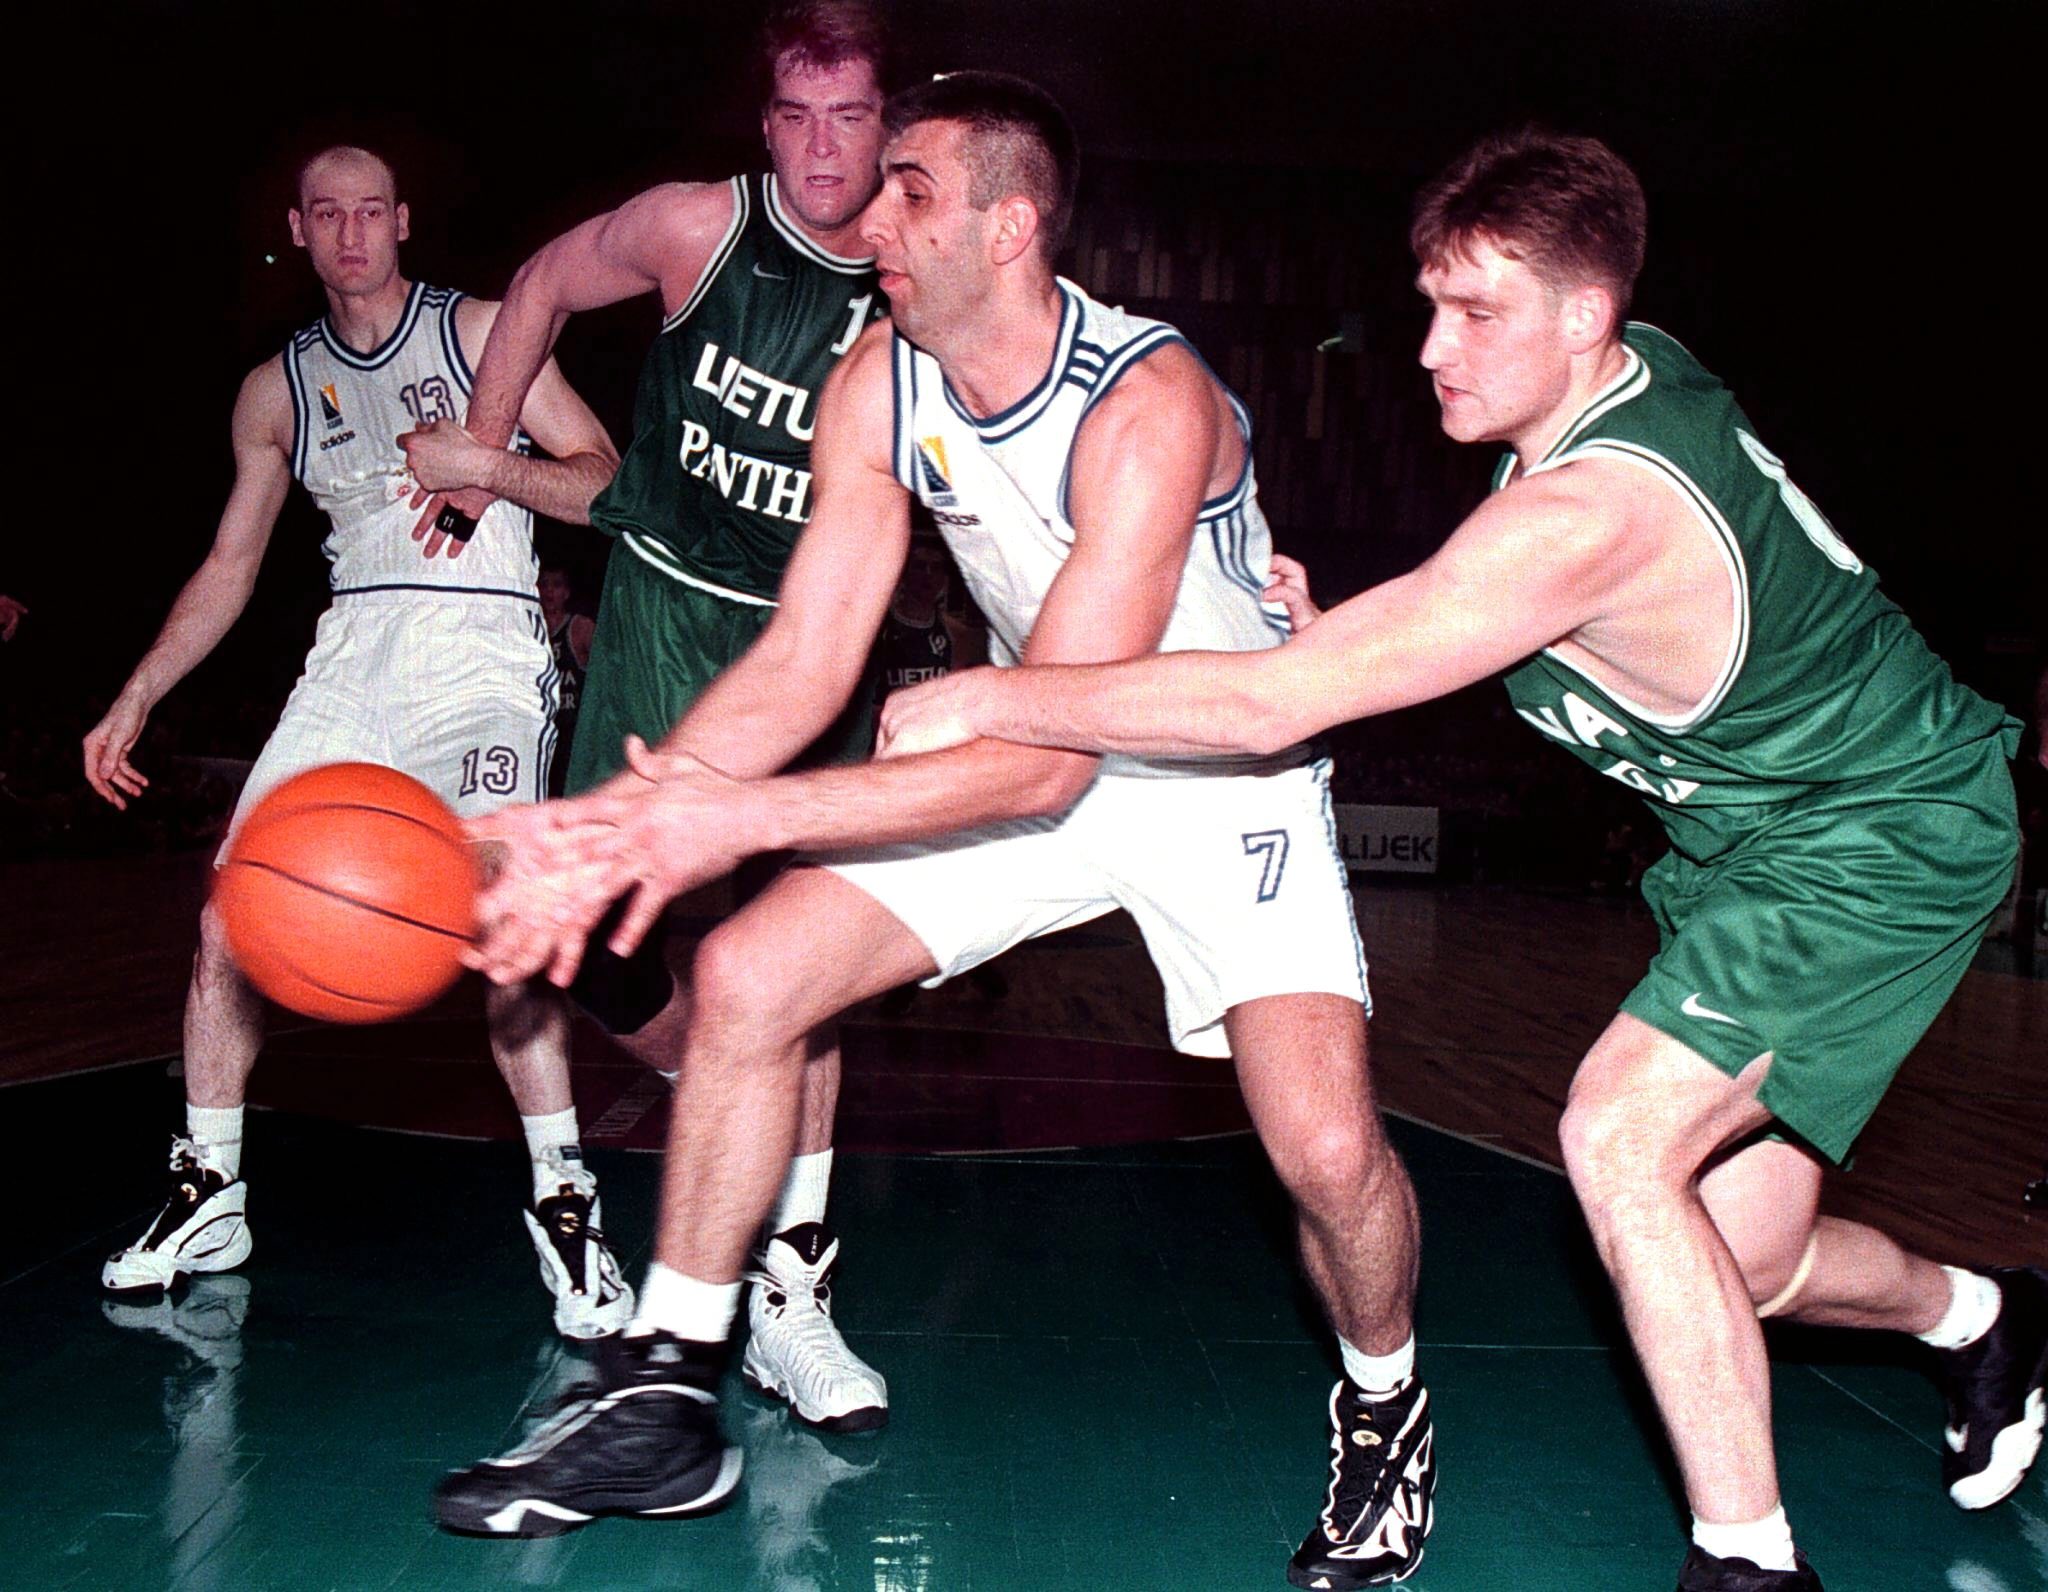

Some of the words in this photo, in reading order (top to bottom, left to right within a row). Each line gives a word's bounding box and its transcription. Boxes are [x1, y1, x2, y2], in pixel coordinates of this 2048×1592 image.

[831, 292, 884, 355] 1
[400, 375, 456, 425] 13
[320, 430, 356, 451] adidas
[680, 419, 814, 524] PANTH
[443, 515, 454, 528] 11
[459, 745, 519, 798] 13
[1241, 829, 1290, 903] 7
[1341, 834, 1434, 862] LIJEK
